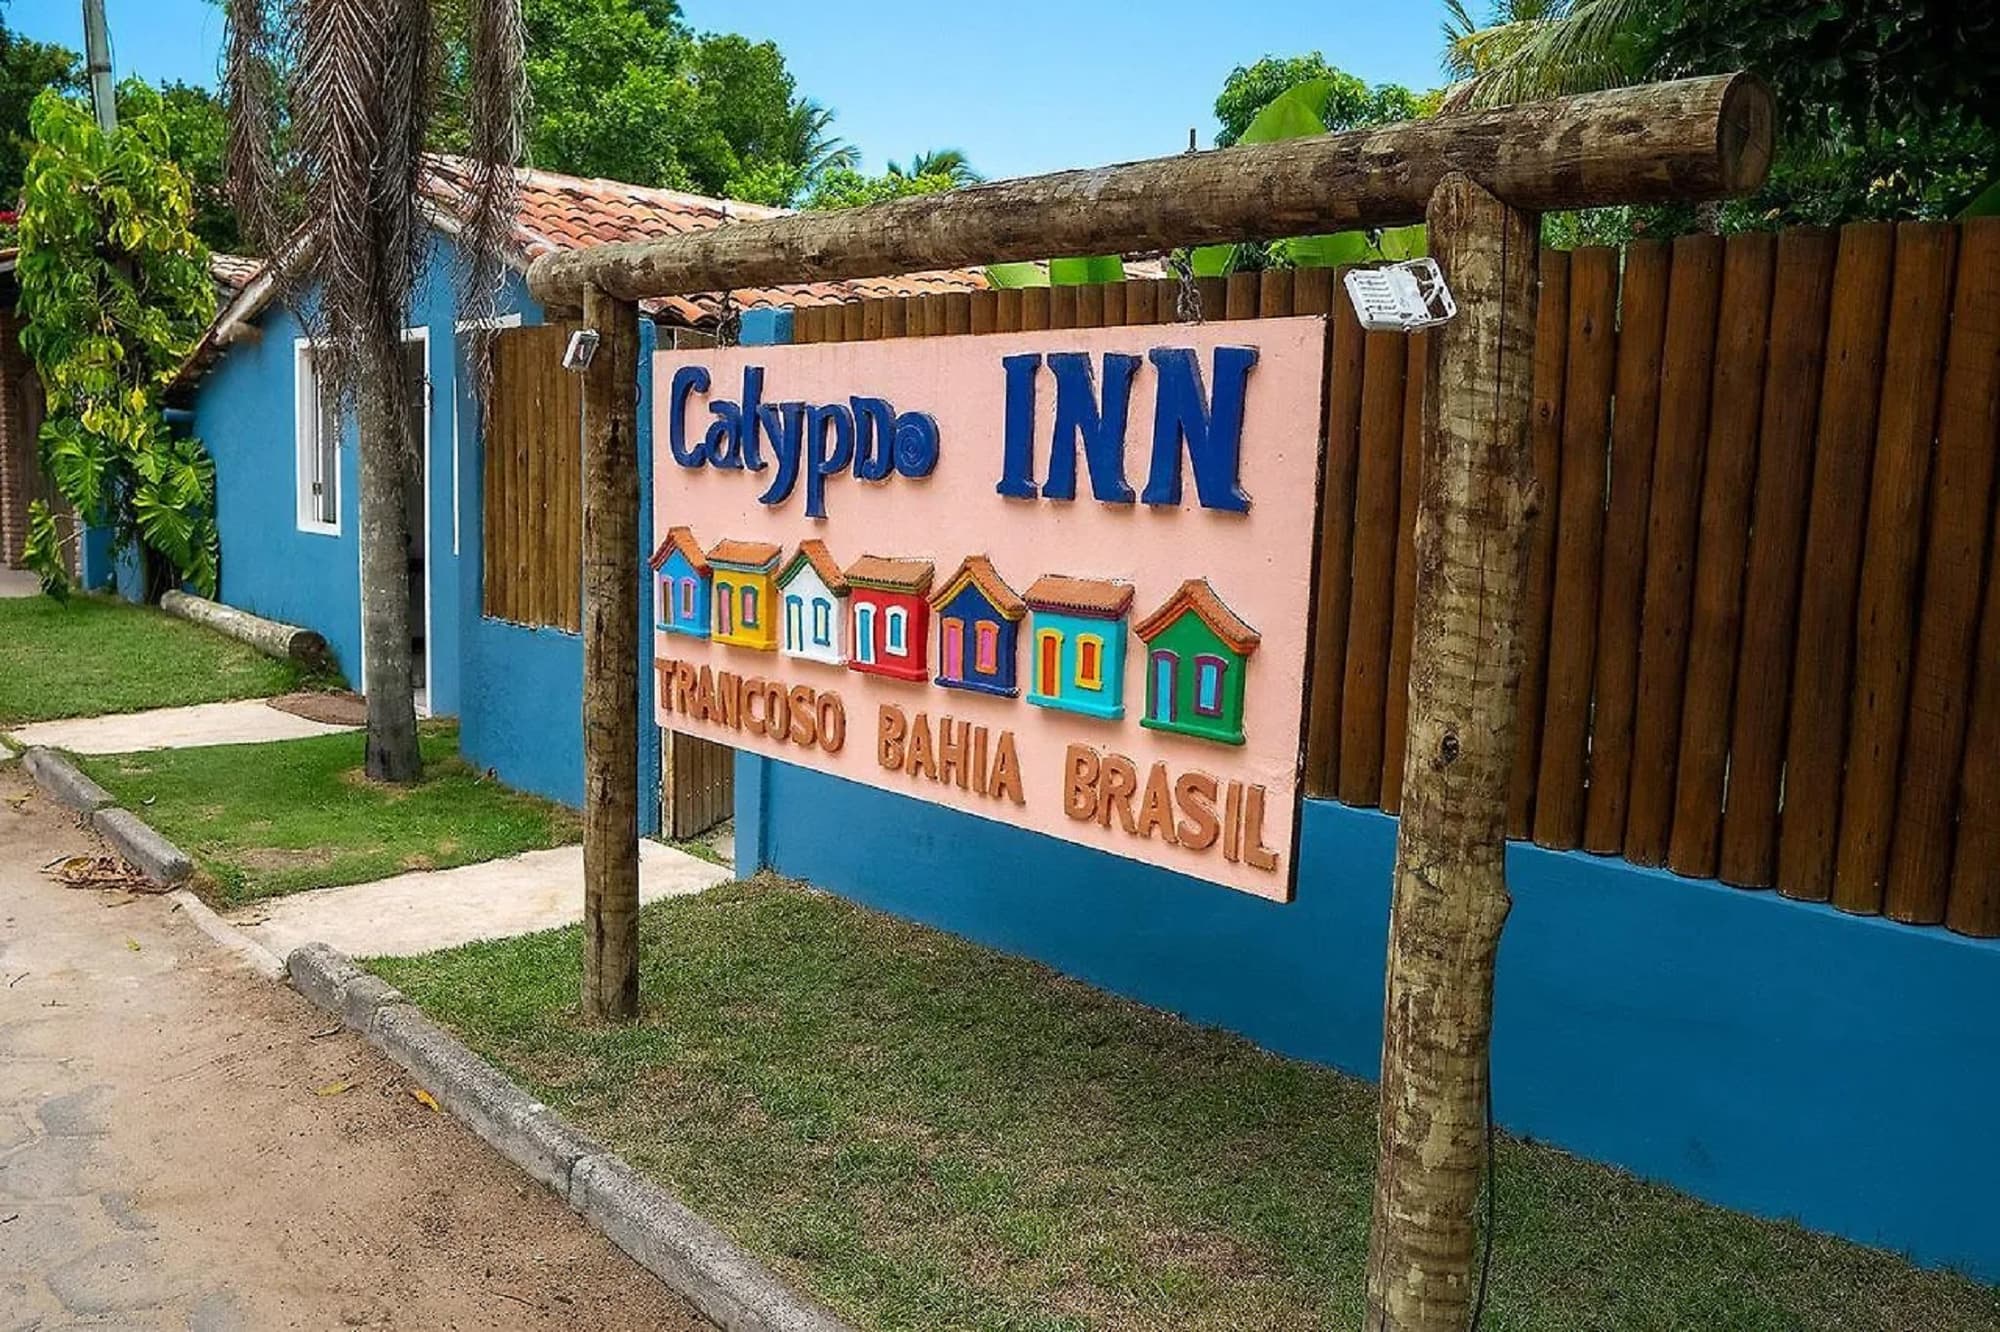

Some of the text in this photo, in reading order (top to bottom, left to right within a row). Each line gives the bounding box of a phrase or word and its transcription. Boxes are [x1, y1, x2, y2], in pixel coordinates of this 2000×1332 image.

[996, 345, 1258, 515] INN
[655, 657, 1279, 872] TRANCOSO BAHIA BRASIL
